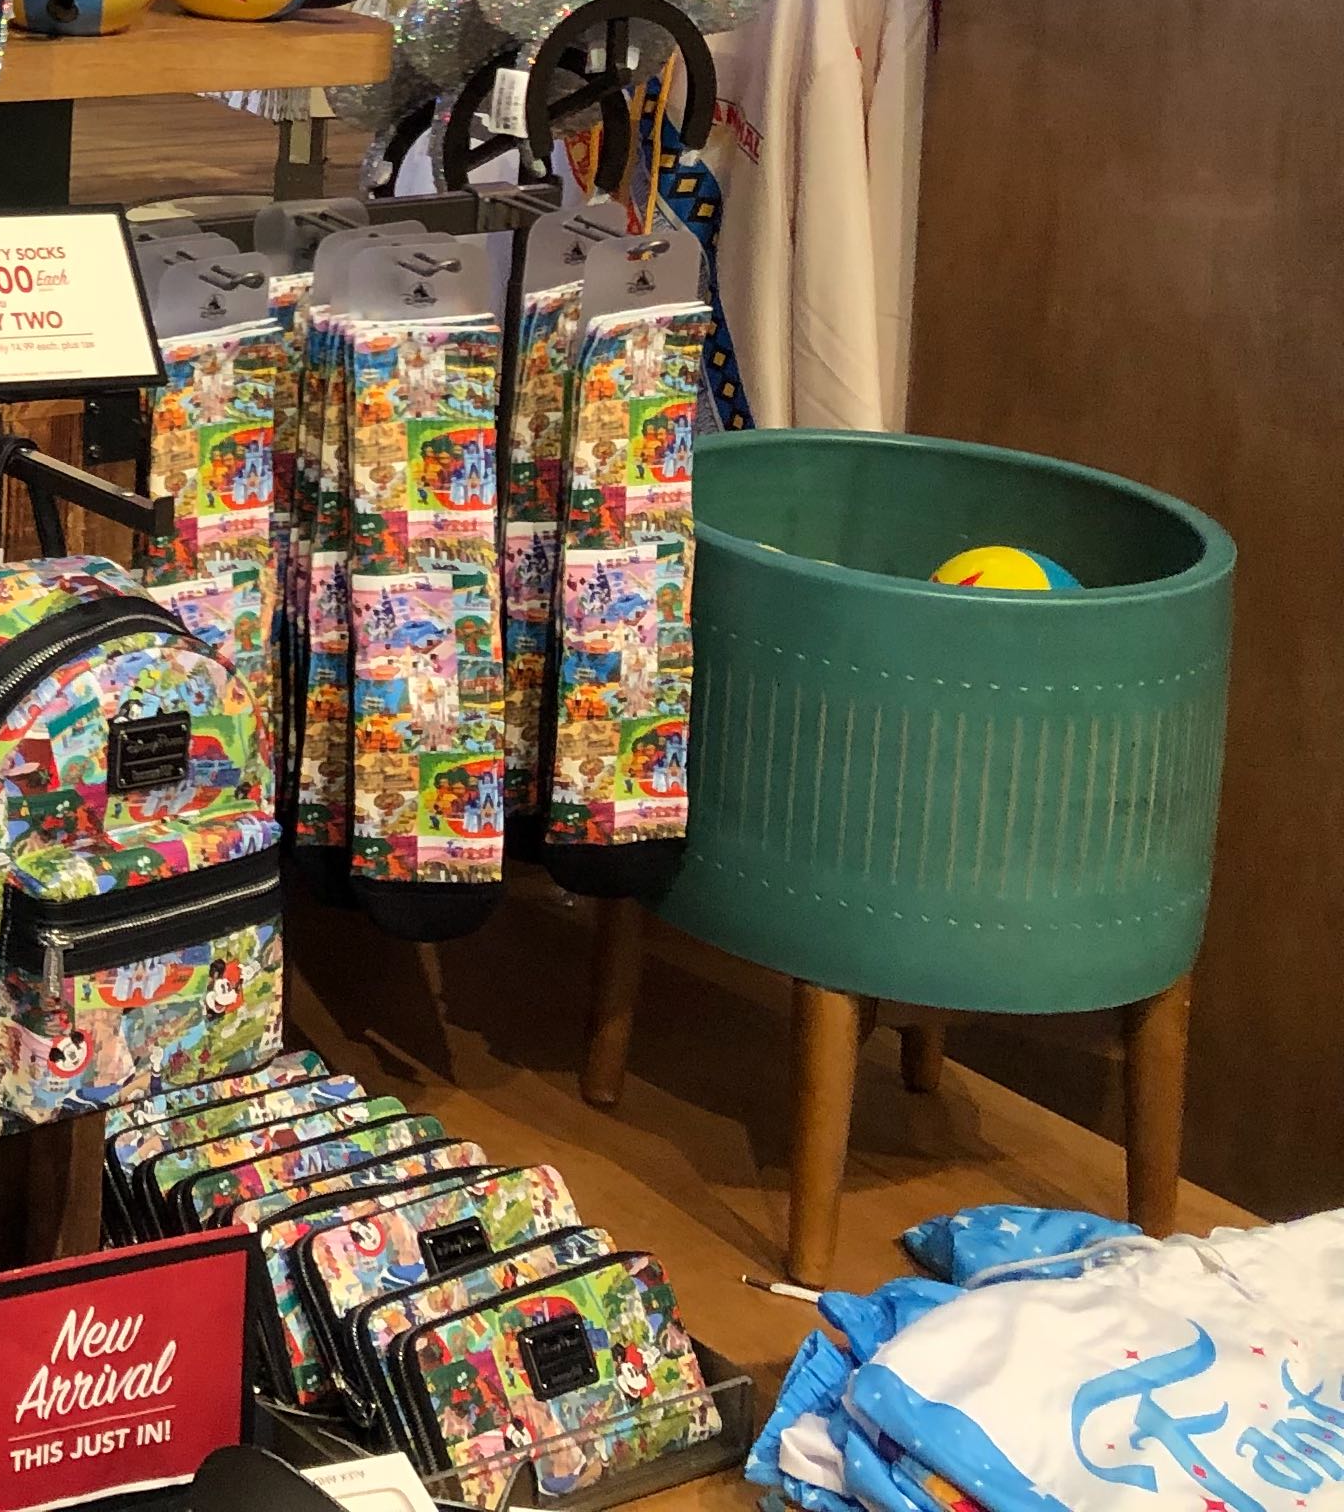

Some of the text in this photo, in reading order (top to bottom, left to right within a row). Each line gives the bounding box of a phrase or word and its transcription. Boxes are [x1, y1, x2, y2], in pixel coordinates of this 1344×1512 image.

[15, 246, 66, 261] SOCKS
[35, 268, 70, 287] Each
[10, 310, 64, 330] TWO
[50, 1305, 145, 1365] New
[15, 1340, 178, 1424] Arrival
[10, 1419, 172, 1473] THIS JUST IN!
